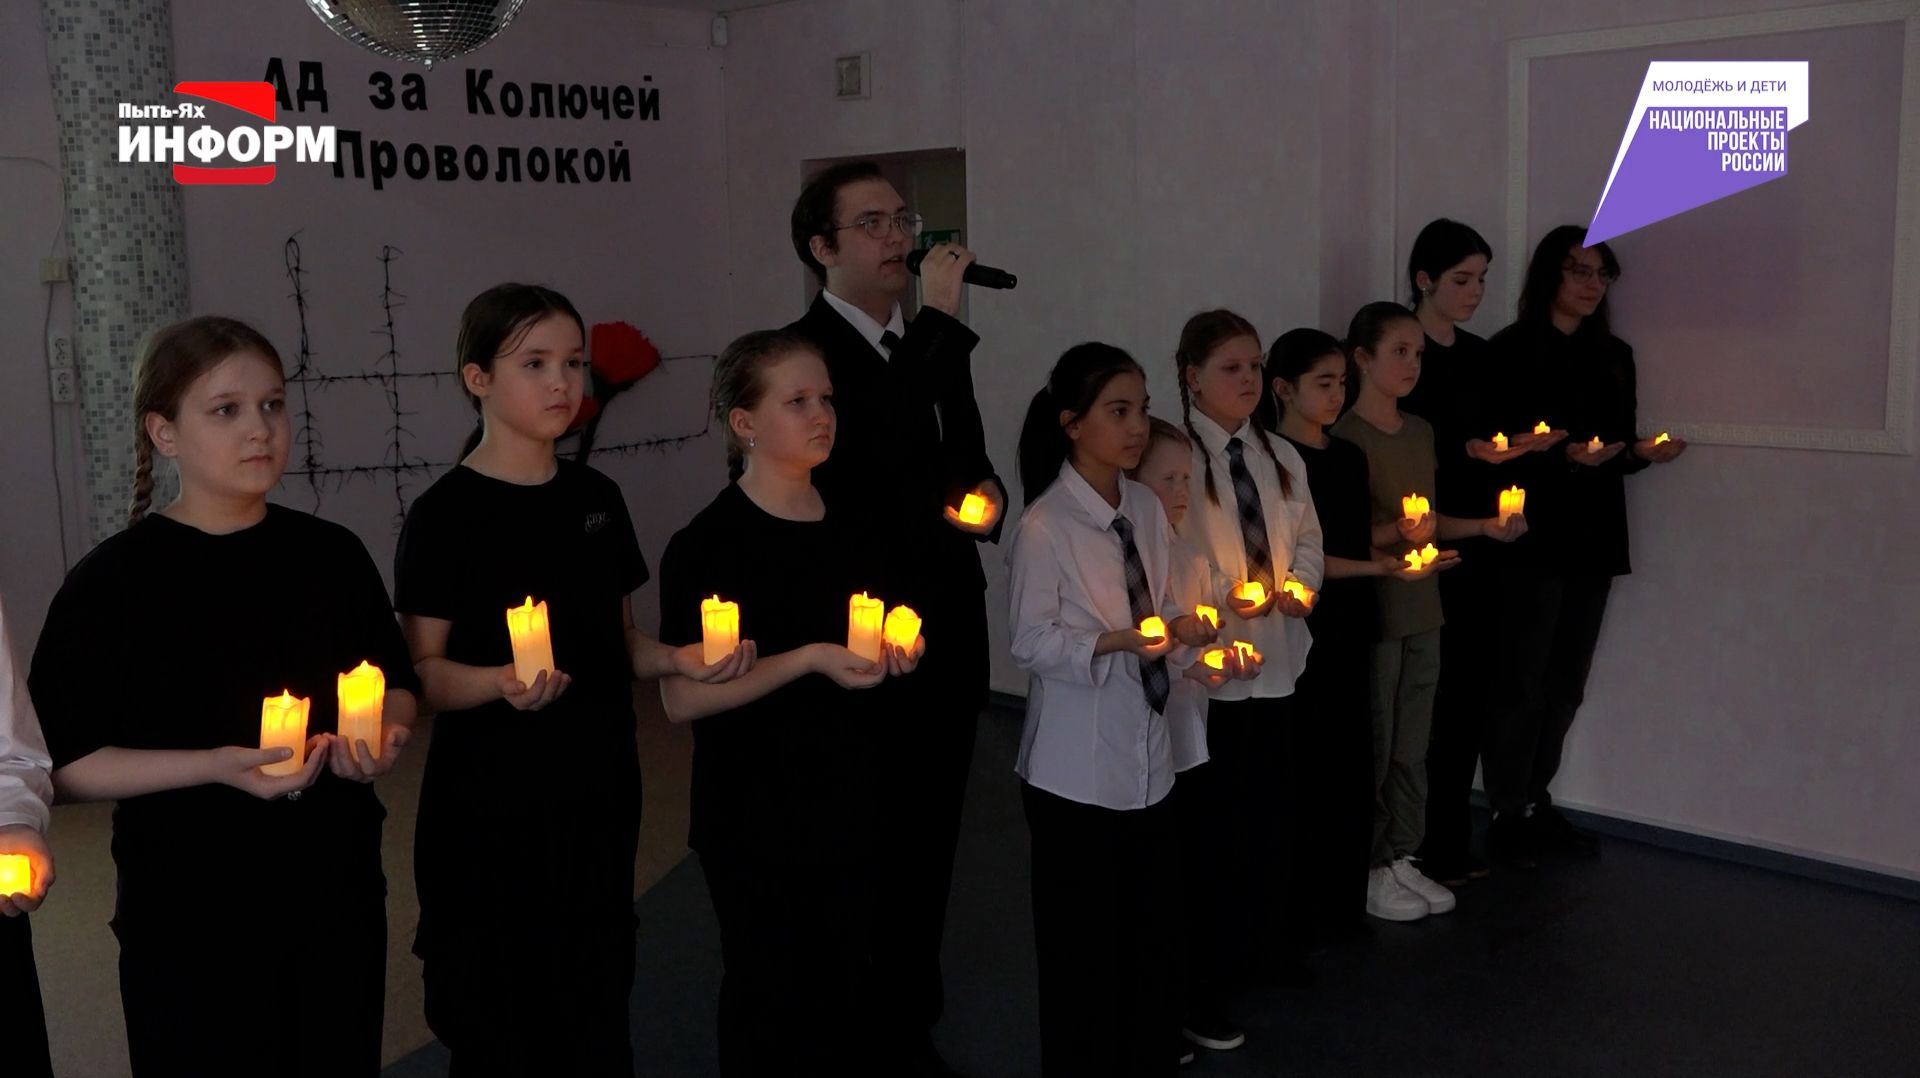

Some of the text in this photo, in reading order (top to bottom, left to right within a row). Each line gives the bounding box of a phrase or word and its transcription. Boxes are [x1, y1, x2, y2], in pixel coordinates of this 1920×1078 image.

[263, 57, 660, 121] АД за Колючей
[333, 129, 631, 190] Проволокой
